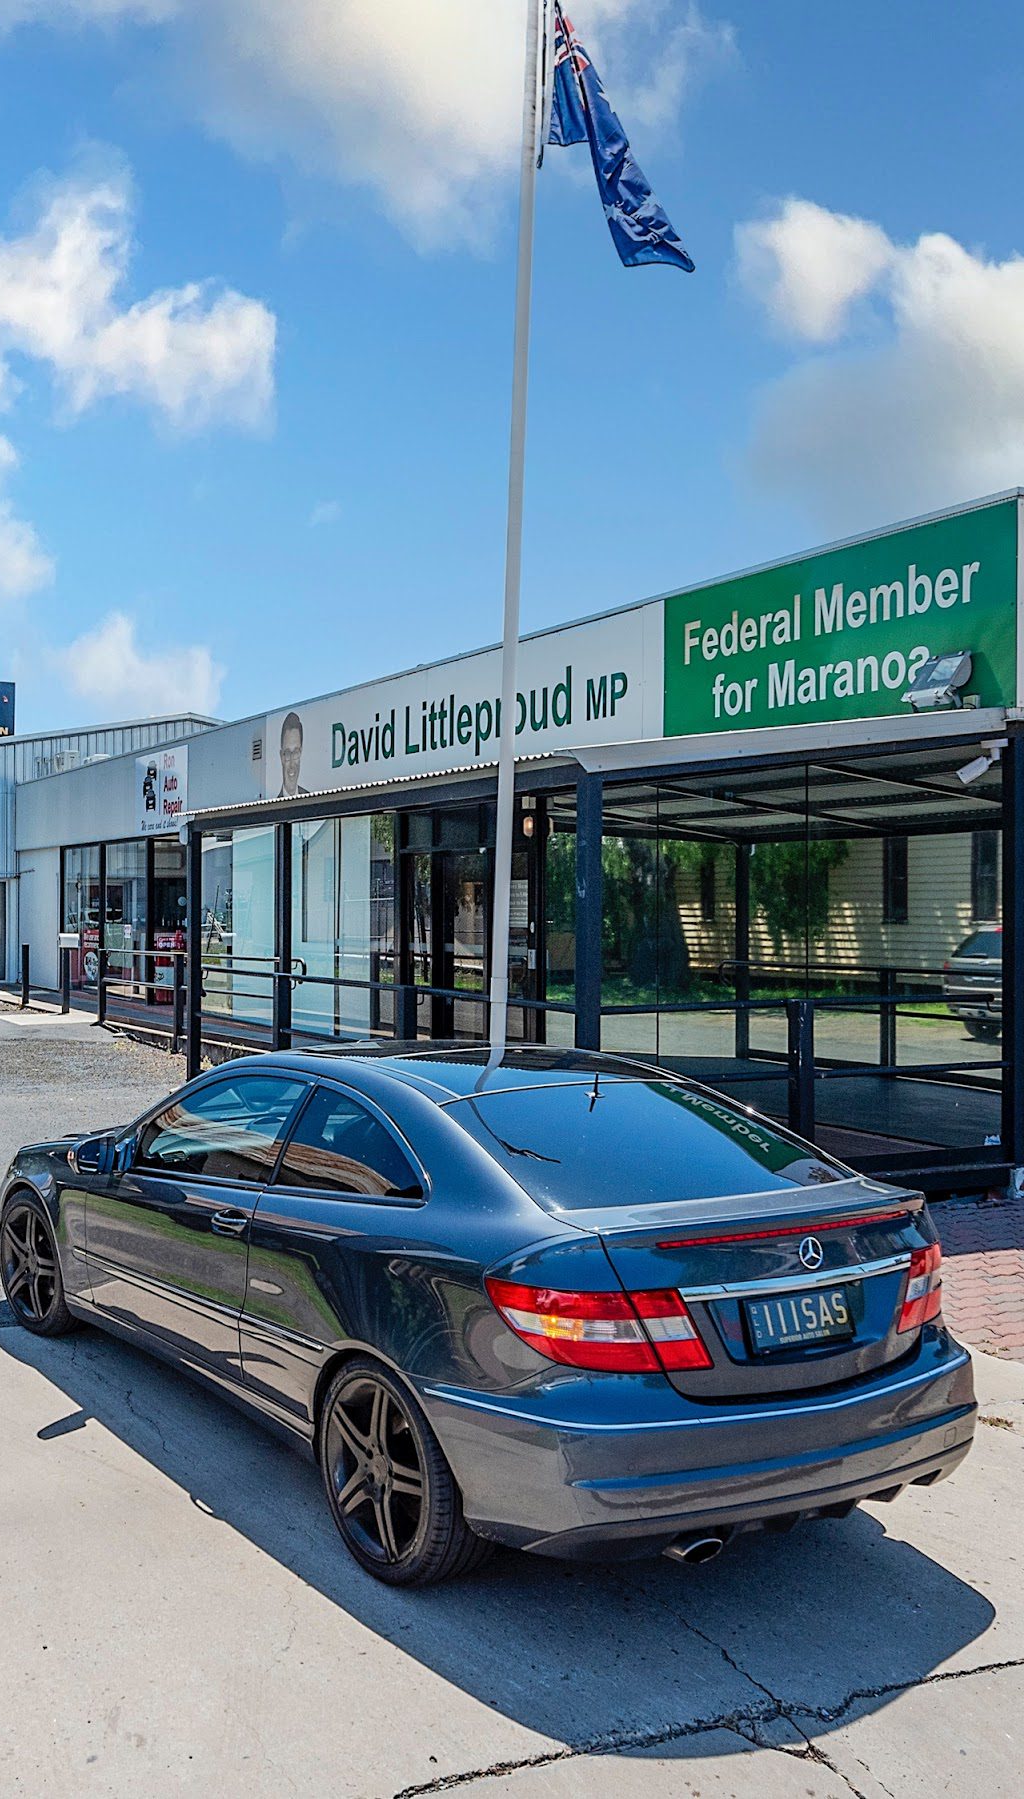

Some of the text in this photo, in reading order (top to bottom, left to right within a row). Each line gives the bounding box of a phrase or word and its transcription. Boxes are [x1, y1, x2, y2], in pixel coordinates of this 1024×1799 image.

[683, 561, 981, 666] Federal Member
[712, 674, 758, 719] for
[331, 708, 395, 769] David
[586, 672, 629, 722] MP
[163, 752, 176, 769] Ron
[163, 775, 178, 793] Auto
[163, 796, 183, 818] Repair
